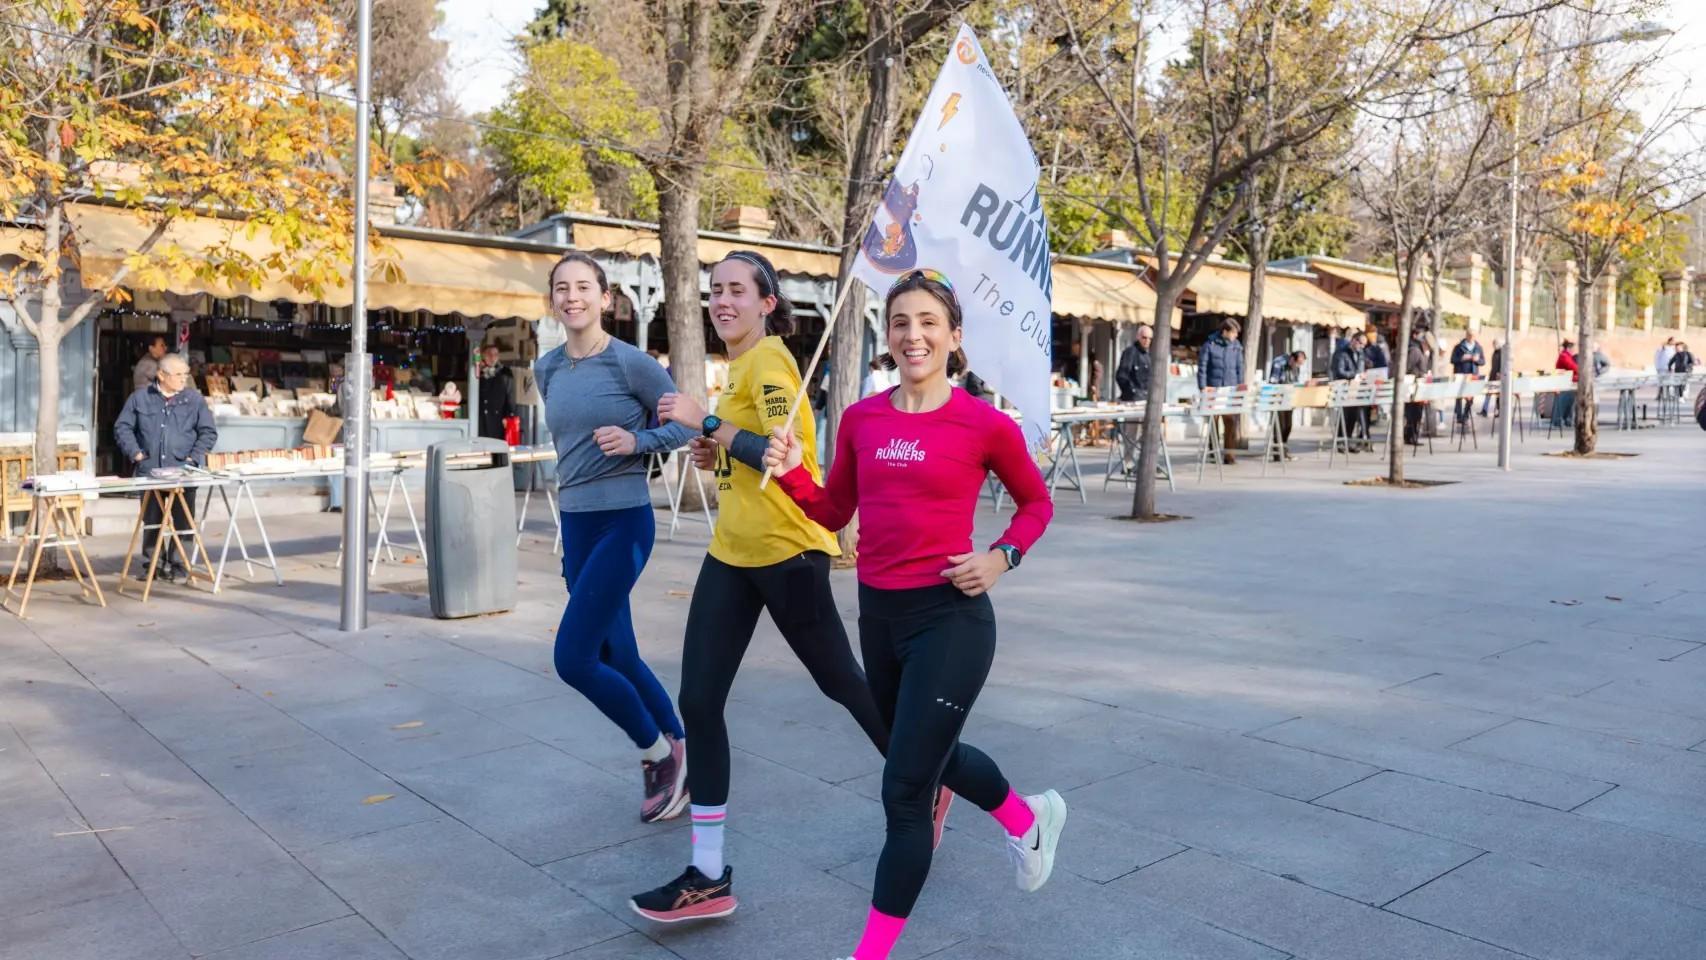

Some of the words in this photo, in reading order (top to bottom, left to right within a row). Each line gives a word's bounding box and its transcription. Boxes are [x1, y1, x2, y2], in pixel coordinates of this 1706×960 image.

[973, 273, 1014, 316] The
[766, 404, 789, 418] 2024
[886, 438, 920, 451] Mad
[875, 447, 926, 462] RUNNERS
